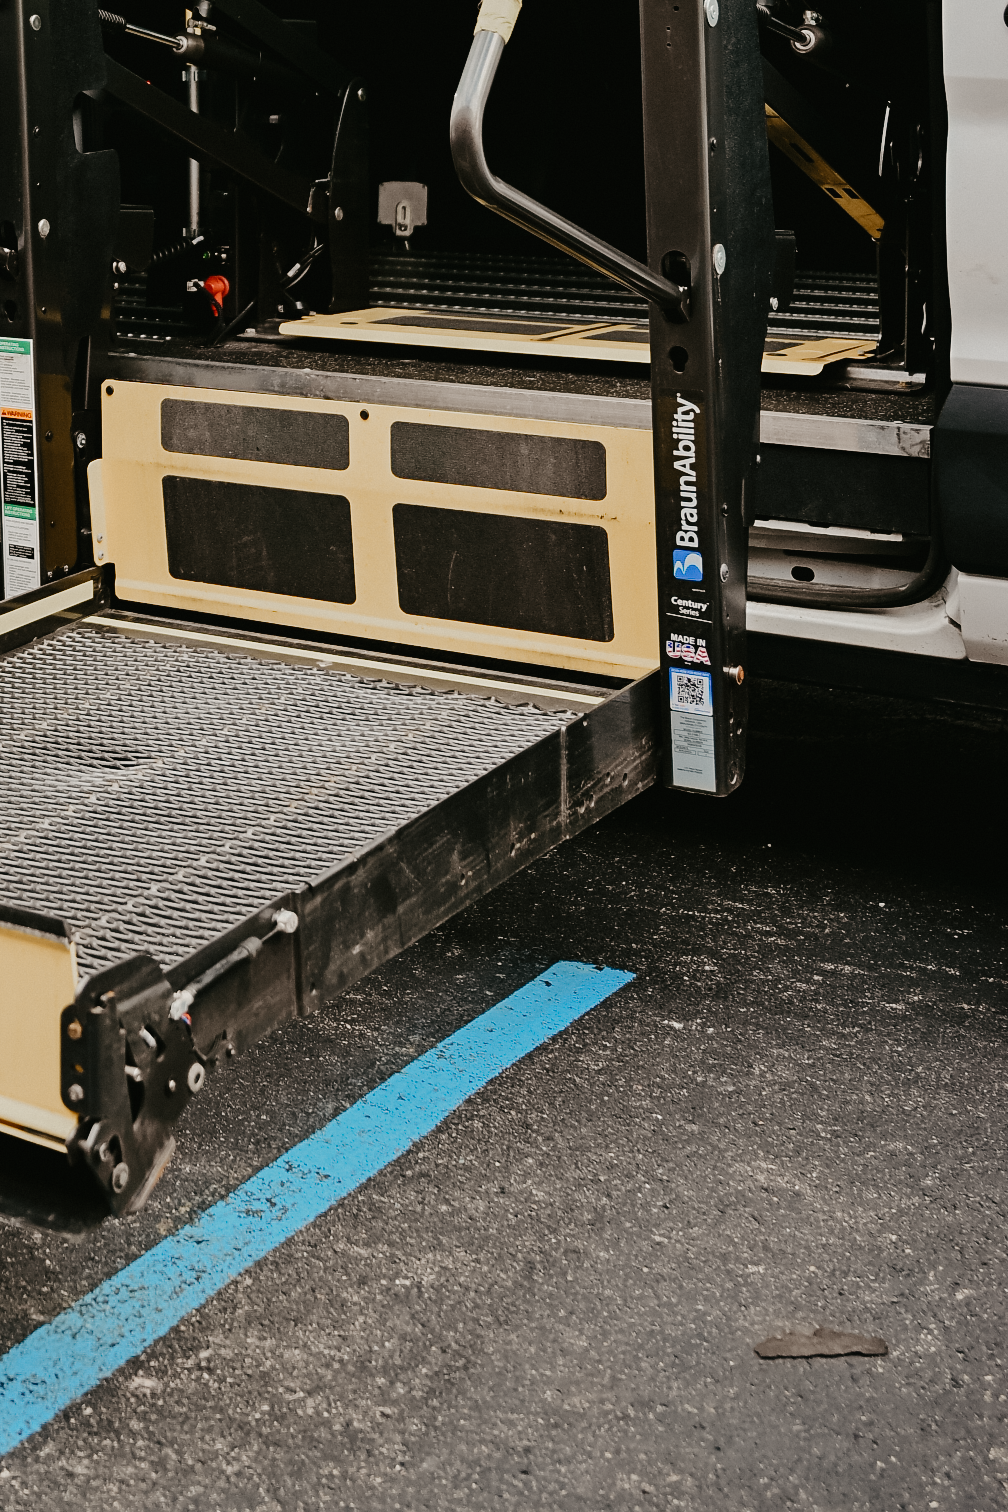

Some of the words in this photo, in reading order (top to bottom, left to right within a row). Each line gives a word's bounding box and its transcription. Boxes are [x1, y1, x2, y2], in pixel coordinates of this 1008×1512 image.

[6, 409, 32, 419] WARNING
[672, 395, 701, 548] BraunAbility
[670, 596, 707, 612] Century
[678, 606, 700, 617] Series
[670, 632, 696, 646] MADE
[696, 638, 706, 647] IN
[665, 640, 712, 666] USA
